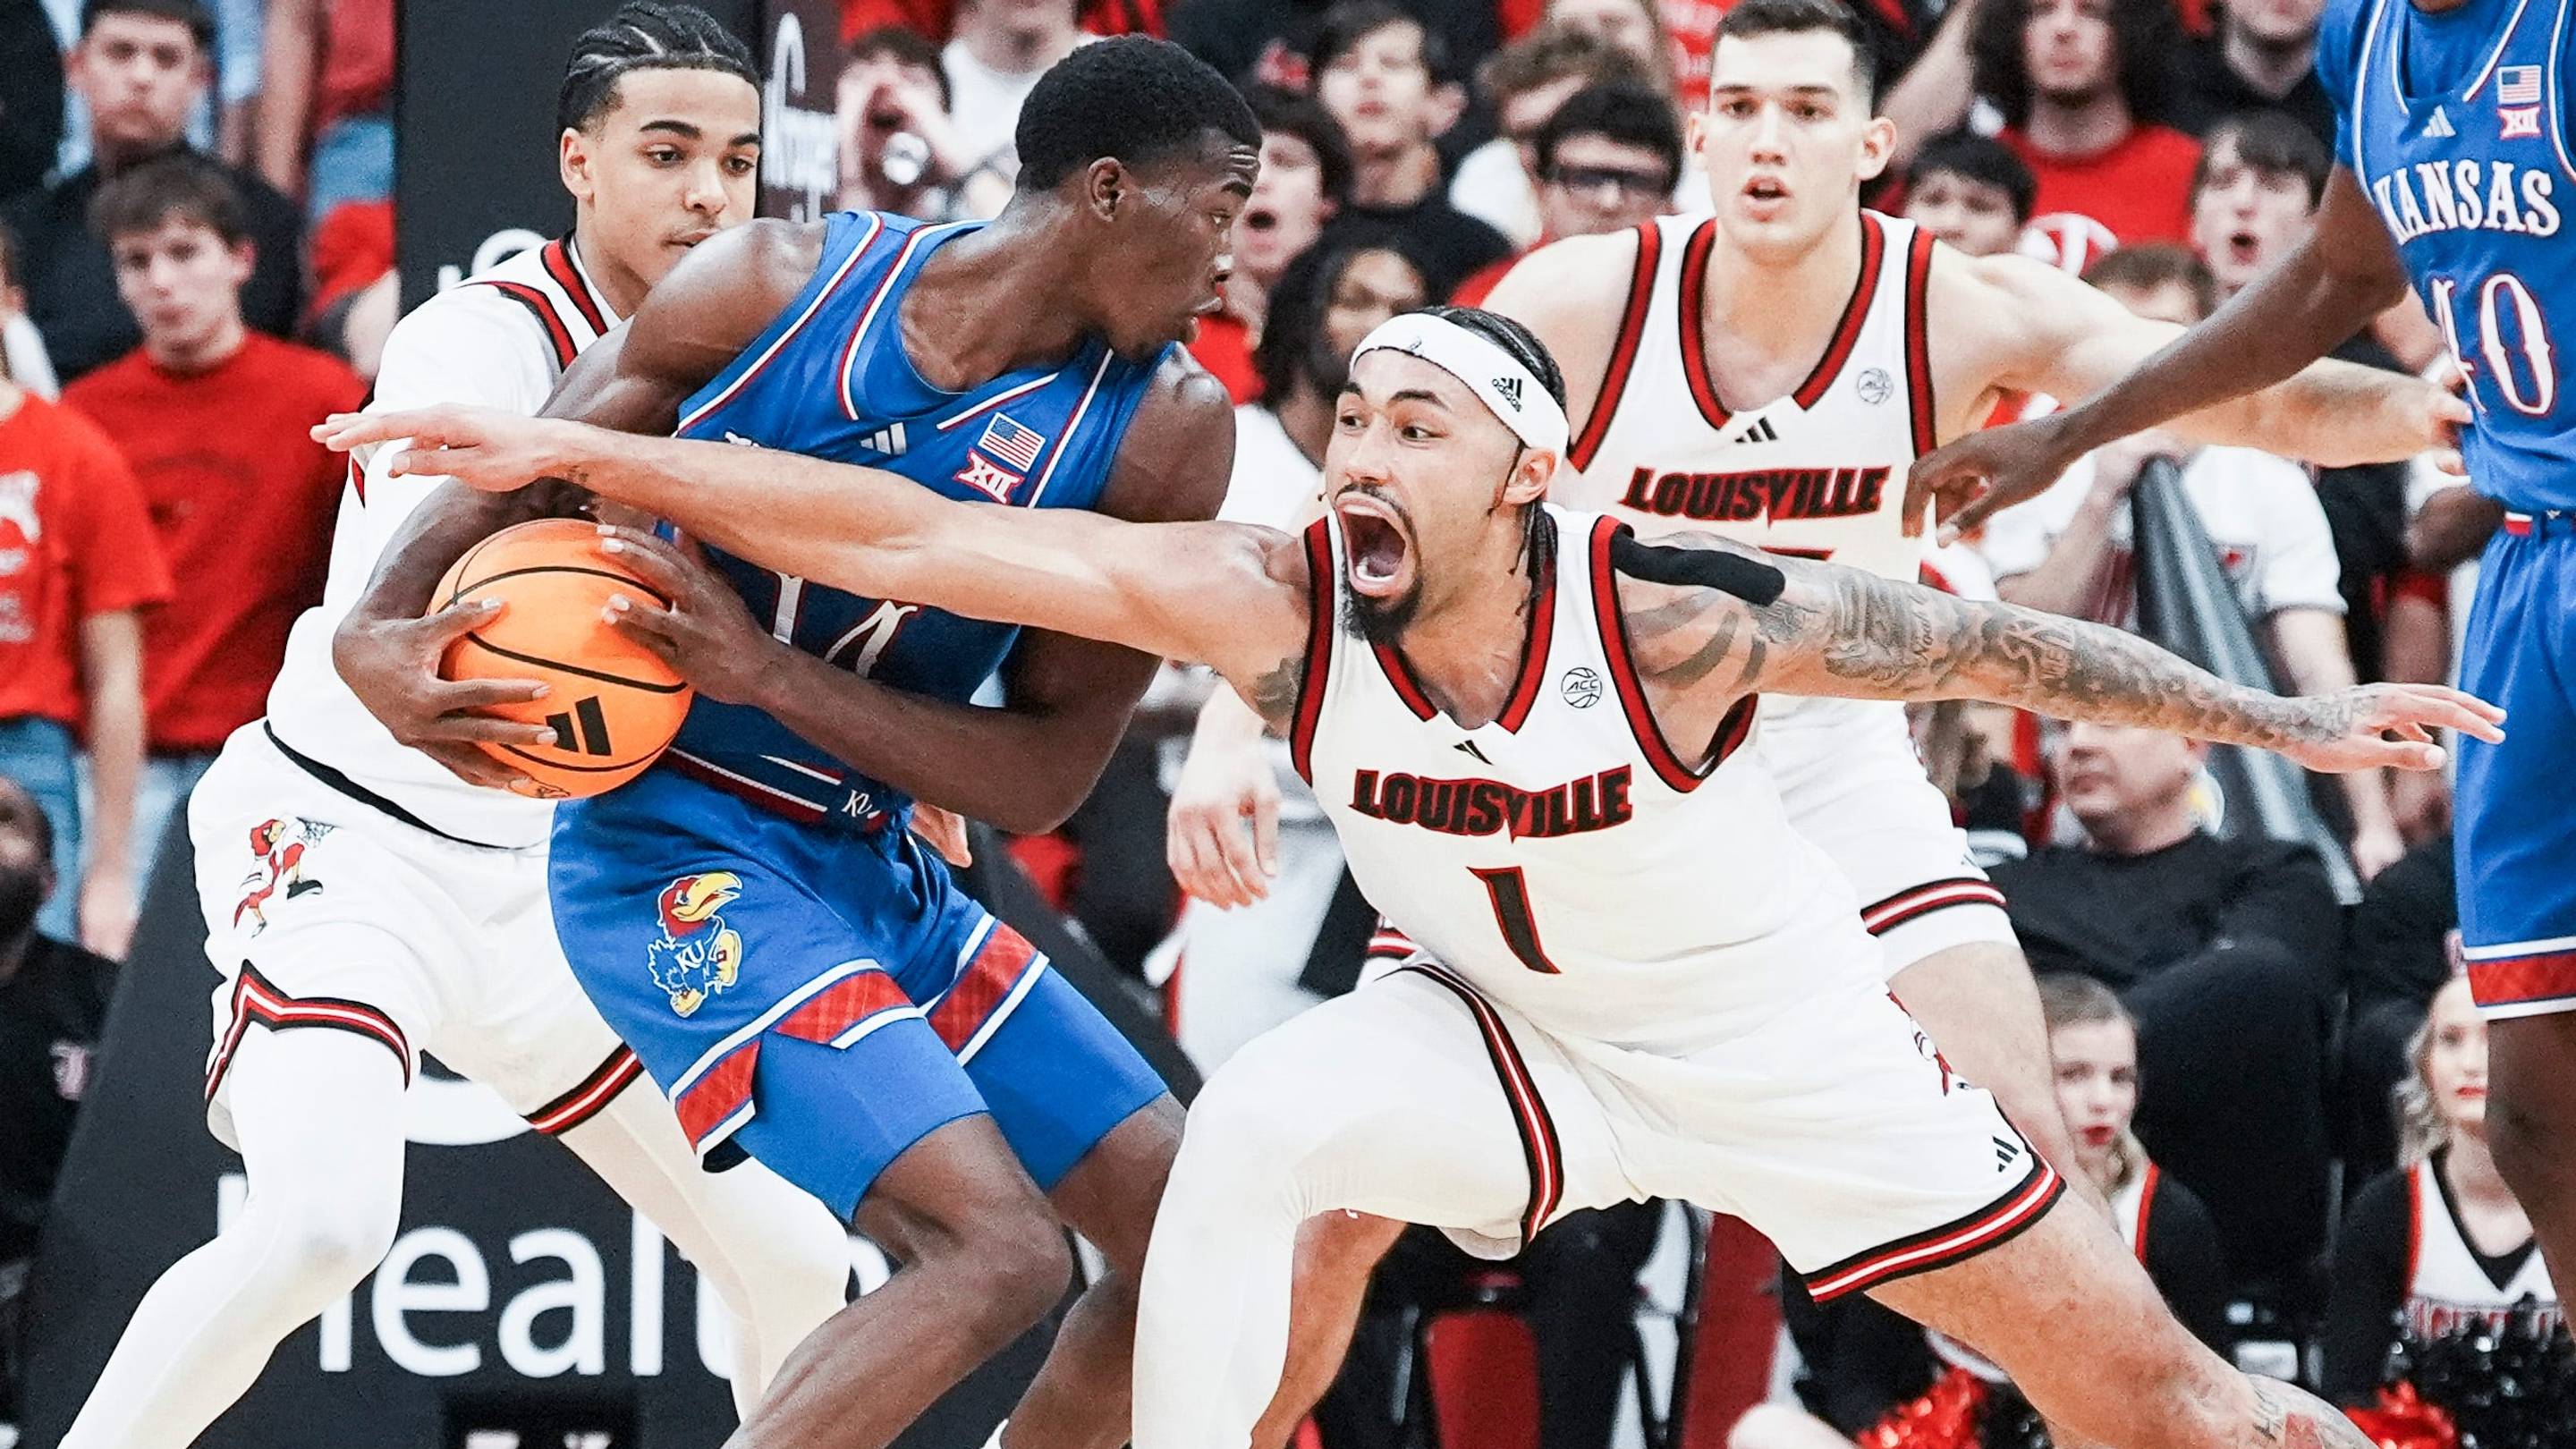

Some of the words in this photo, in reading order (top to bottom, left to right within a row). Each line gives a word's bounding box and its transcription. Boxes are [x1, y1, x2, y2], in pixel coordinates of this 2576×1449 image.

[2373, 158, 2561, 246] KANSAS
[1492, 378, 1521, 412] adidas
[953, 448, 1024, 504] XII
[1617, 466, 1891, 529] LOUISVILLE
[1566, 679, 1598, 691] ACC
[1348, 764, 1632, 843] LOUISVILLE
[1466, 865, 1562, 974] 1
[674, 939, 705, 973] KU
